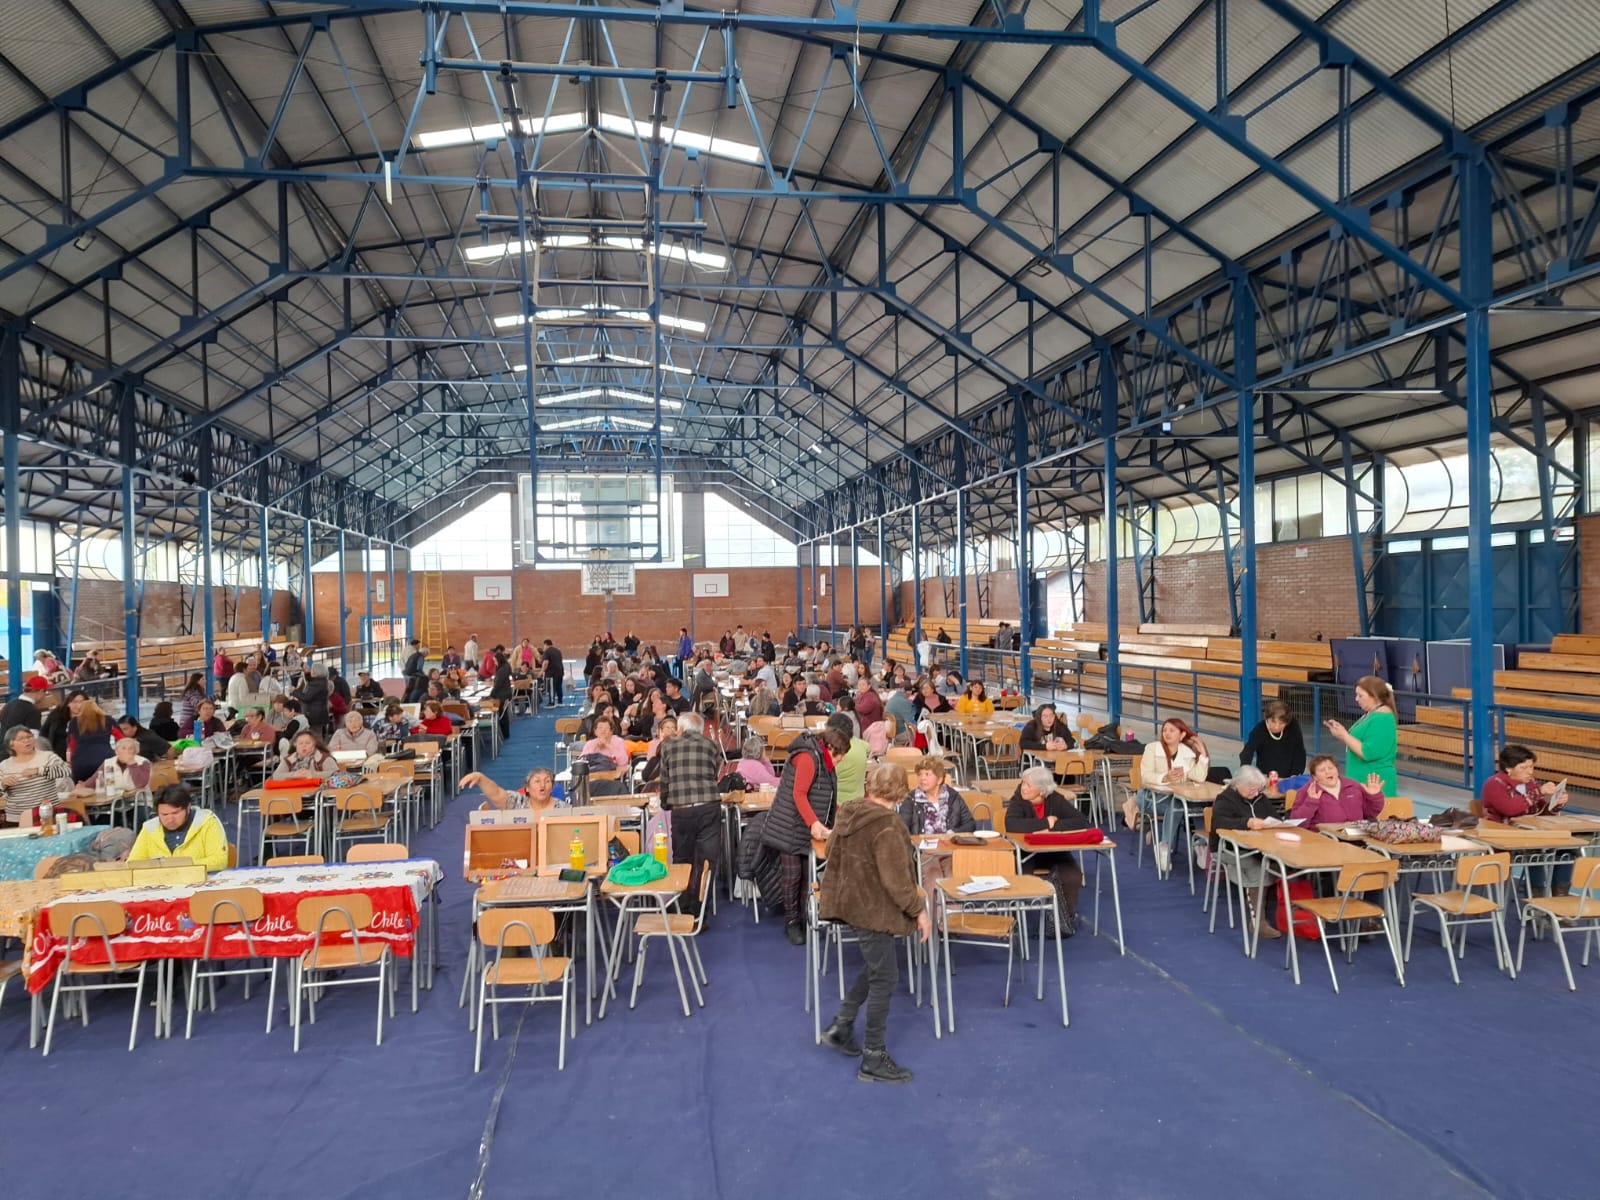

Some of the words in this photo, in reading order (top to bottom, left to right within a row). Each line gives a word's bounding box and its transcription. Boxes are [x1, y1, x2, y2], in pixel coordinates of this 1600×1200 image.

[134, 913, 174, 933] Chile
[255, 914, 293, 932] Chile
[371, 910, 405, 929] Chile
